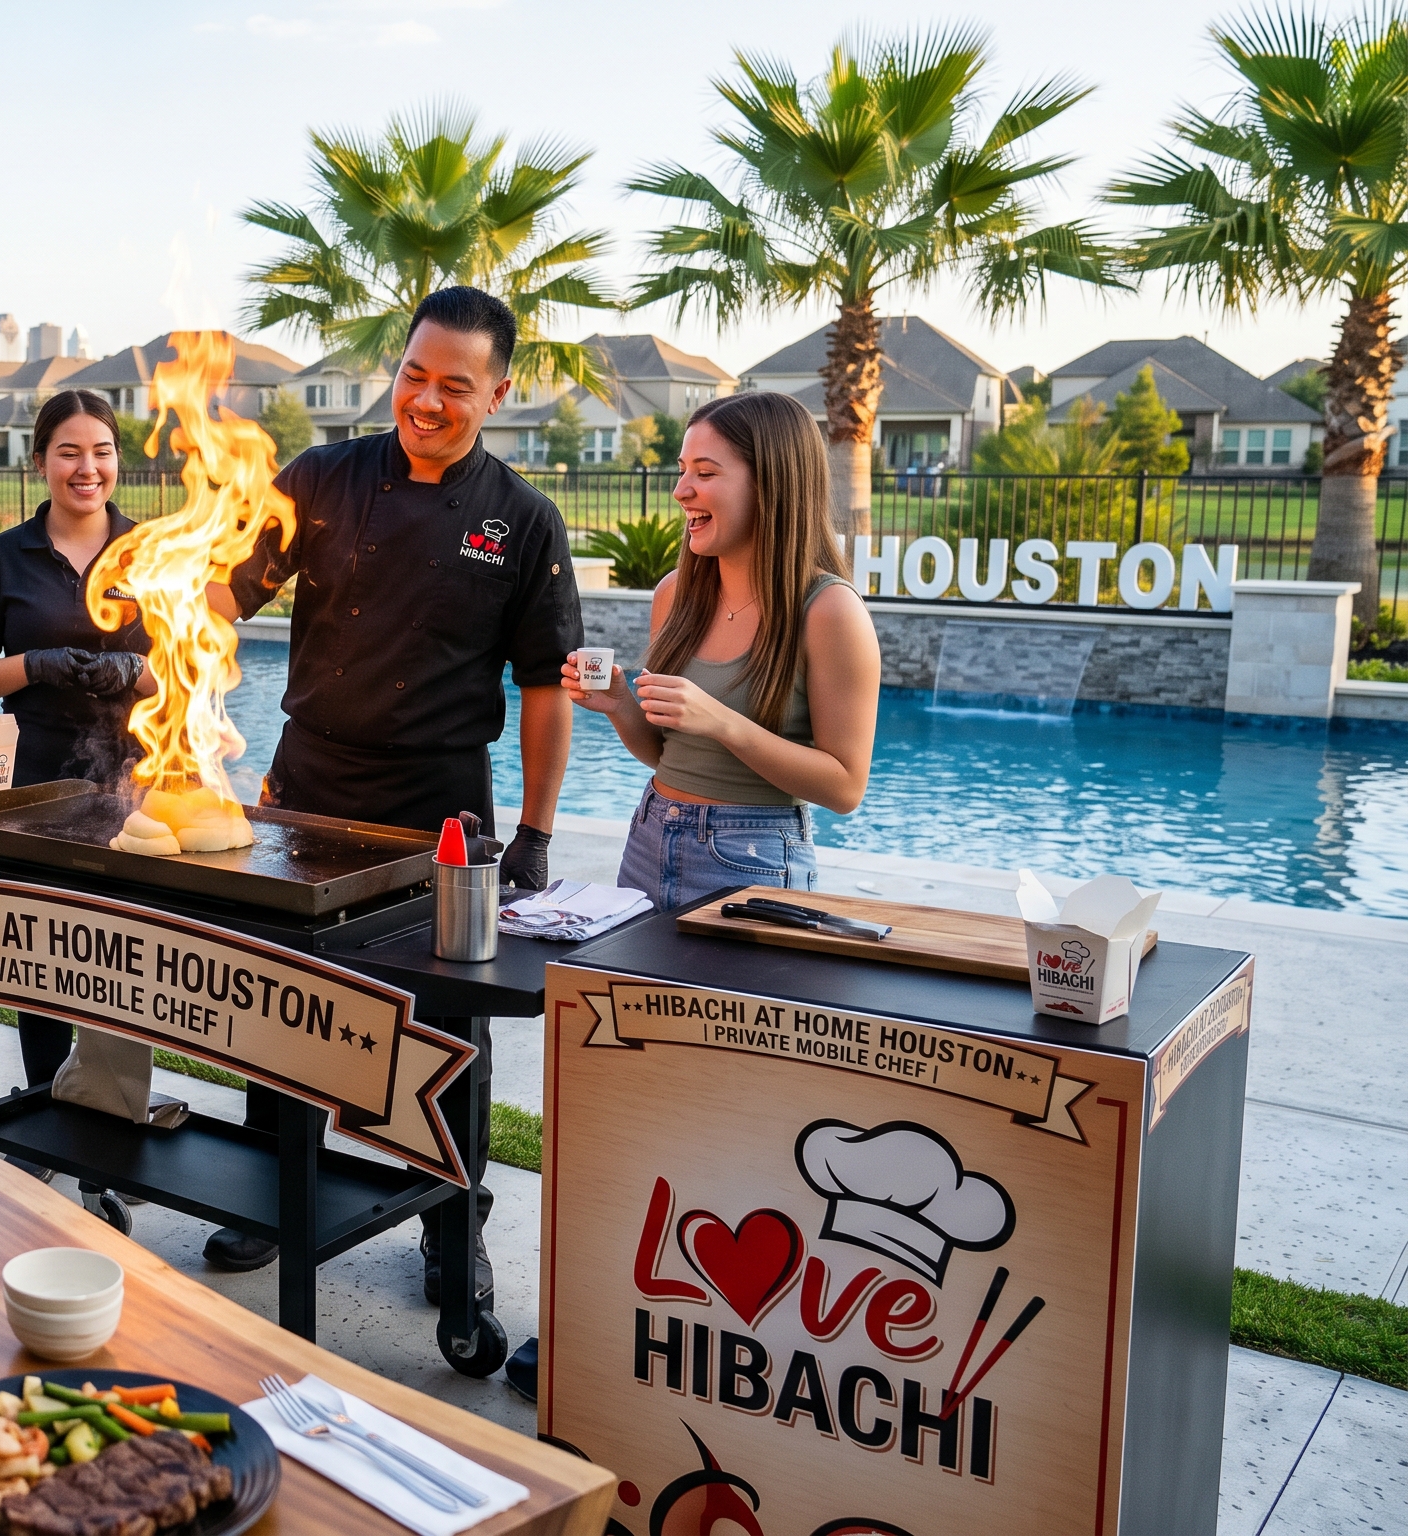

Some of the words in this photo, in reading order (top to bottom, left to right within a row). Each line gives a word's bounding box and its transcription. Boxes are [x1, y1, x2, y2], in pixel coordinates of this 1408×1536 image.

[853, 534, 1240, 612] HOUSTON
[2, 911, 38, 952] AT
[48, 918, 145, 978] HOME
[156, 943, 335, 1042] HOUSTON
[55, 966, 145, 1015] MOBILE
[152, 992, 219, 1036] CHEF
[1037, 967, 1095, 991] HIBACHI
[645, 993, 745, 1024] HIBACHI
[753, 1004, 786, 1029] AT
[793, 1010, 871, 1045] HOME
[879, 1025, 1015, 1080] HOUSTON
[714, 1025, 791, 1052] PRIVATE
[796, 1037, 869, 1067] MOBILE
[874, 1052, 928, 1078] CHEF
[633, 1308, 997, 1484] HIBACHI
